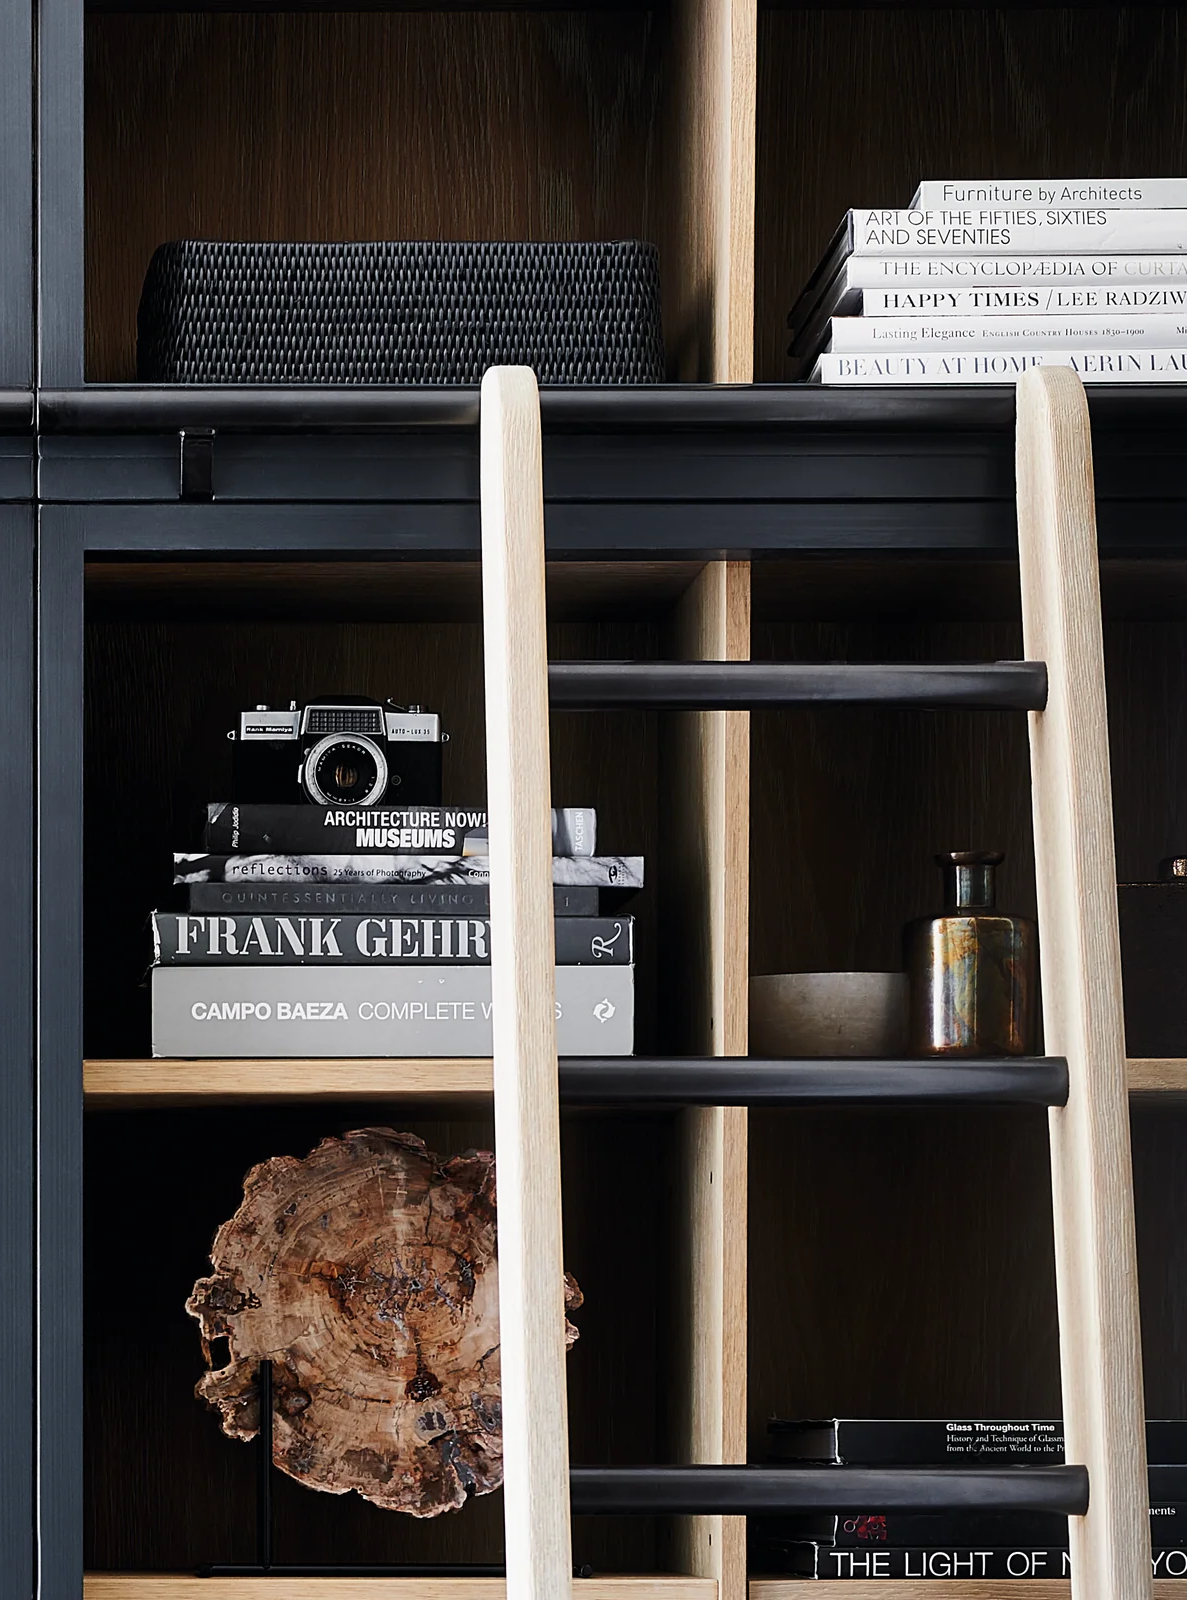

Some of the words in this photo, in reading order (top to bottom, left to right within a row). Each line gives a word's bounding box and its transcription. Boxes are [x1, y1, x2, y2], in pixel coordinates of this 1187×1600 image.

[943, 184, 1032, 201] Furniture
[1039, 187, 1056, 204] by
[1060, 186, 1142, 200] Architects
[866, 211, 900, 225] ART
[908, 211, 933, 225] OF
[939, 211, 972, 225] THE
[980, 211, 1042, 226] FIFTIES,
[1046, 210, 1107, 225] SIXTIES
[866, 229, 910, 244] AND
[916, 229, 1011, 244] SEVENTIES
[880, 262, 921, 275] THE
[928, 262, 1085, 275] ENCYCLOPÆDIA
[1091, 262, 1118, 275] OF
[884, 293, 962, 308] HAPPY
[969, 292, 1039, 307] TIMES
[873, 328, 917, 341] Lasting
[921, 327, 975, 340] Elegance
[839, 359, 934, 376] BEAUTY
[937, 358, 967, 374] AT
[324, 811, 440, 827] ARCHITECTURE
[446, 812, 487, 828] NOW!
[356, 828, 455, 848] MUSEUMS
[575, 812, 583, 851] TASCHEN
[232, 863, 327, 876] reflections
[376, 868, 426, 878] Photography
[175, 917, 343, 956] FRANK
[356, 919, 491, 958] GEHR
[191, 1002, 271, 1020] CAMPO
[277, 1002, 348, 1020] BAEZA
[358, 1002, 474, 1020] COMPLETE
[946, 1423, 972, 1432] Glass
[974, 1423, 1030, 1433] Throughout
[1031, 1423, 1055, 1431] Time
[1009, 1444, 1031, 1452] World
[1043, 1444, 1060, 1452] the
[830, 1552, 891, 1577] THE
[904, 1552, 994, 1577] LIGHT
[1007, 1552, 1047, 1576] OF
